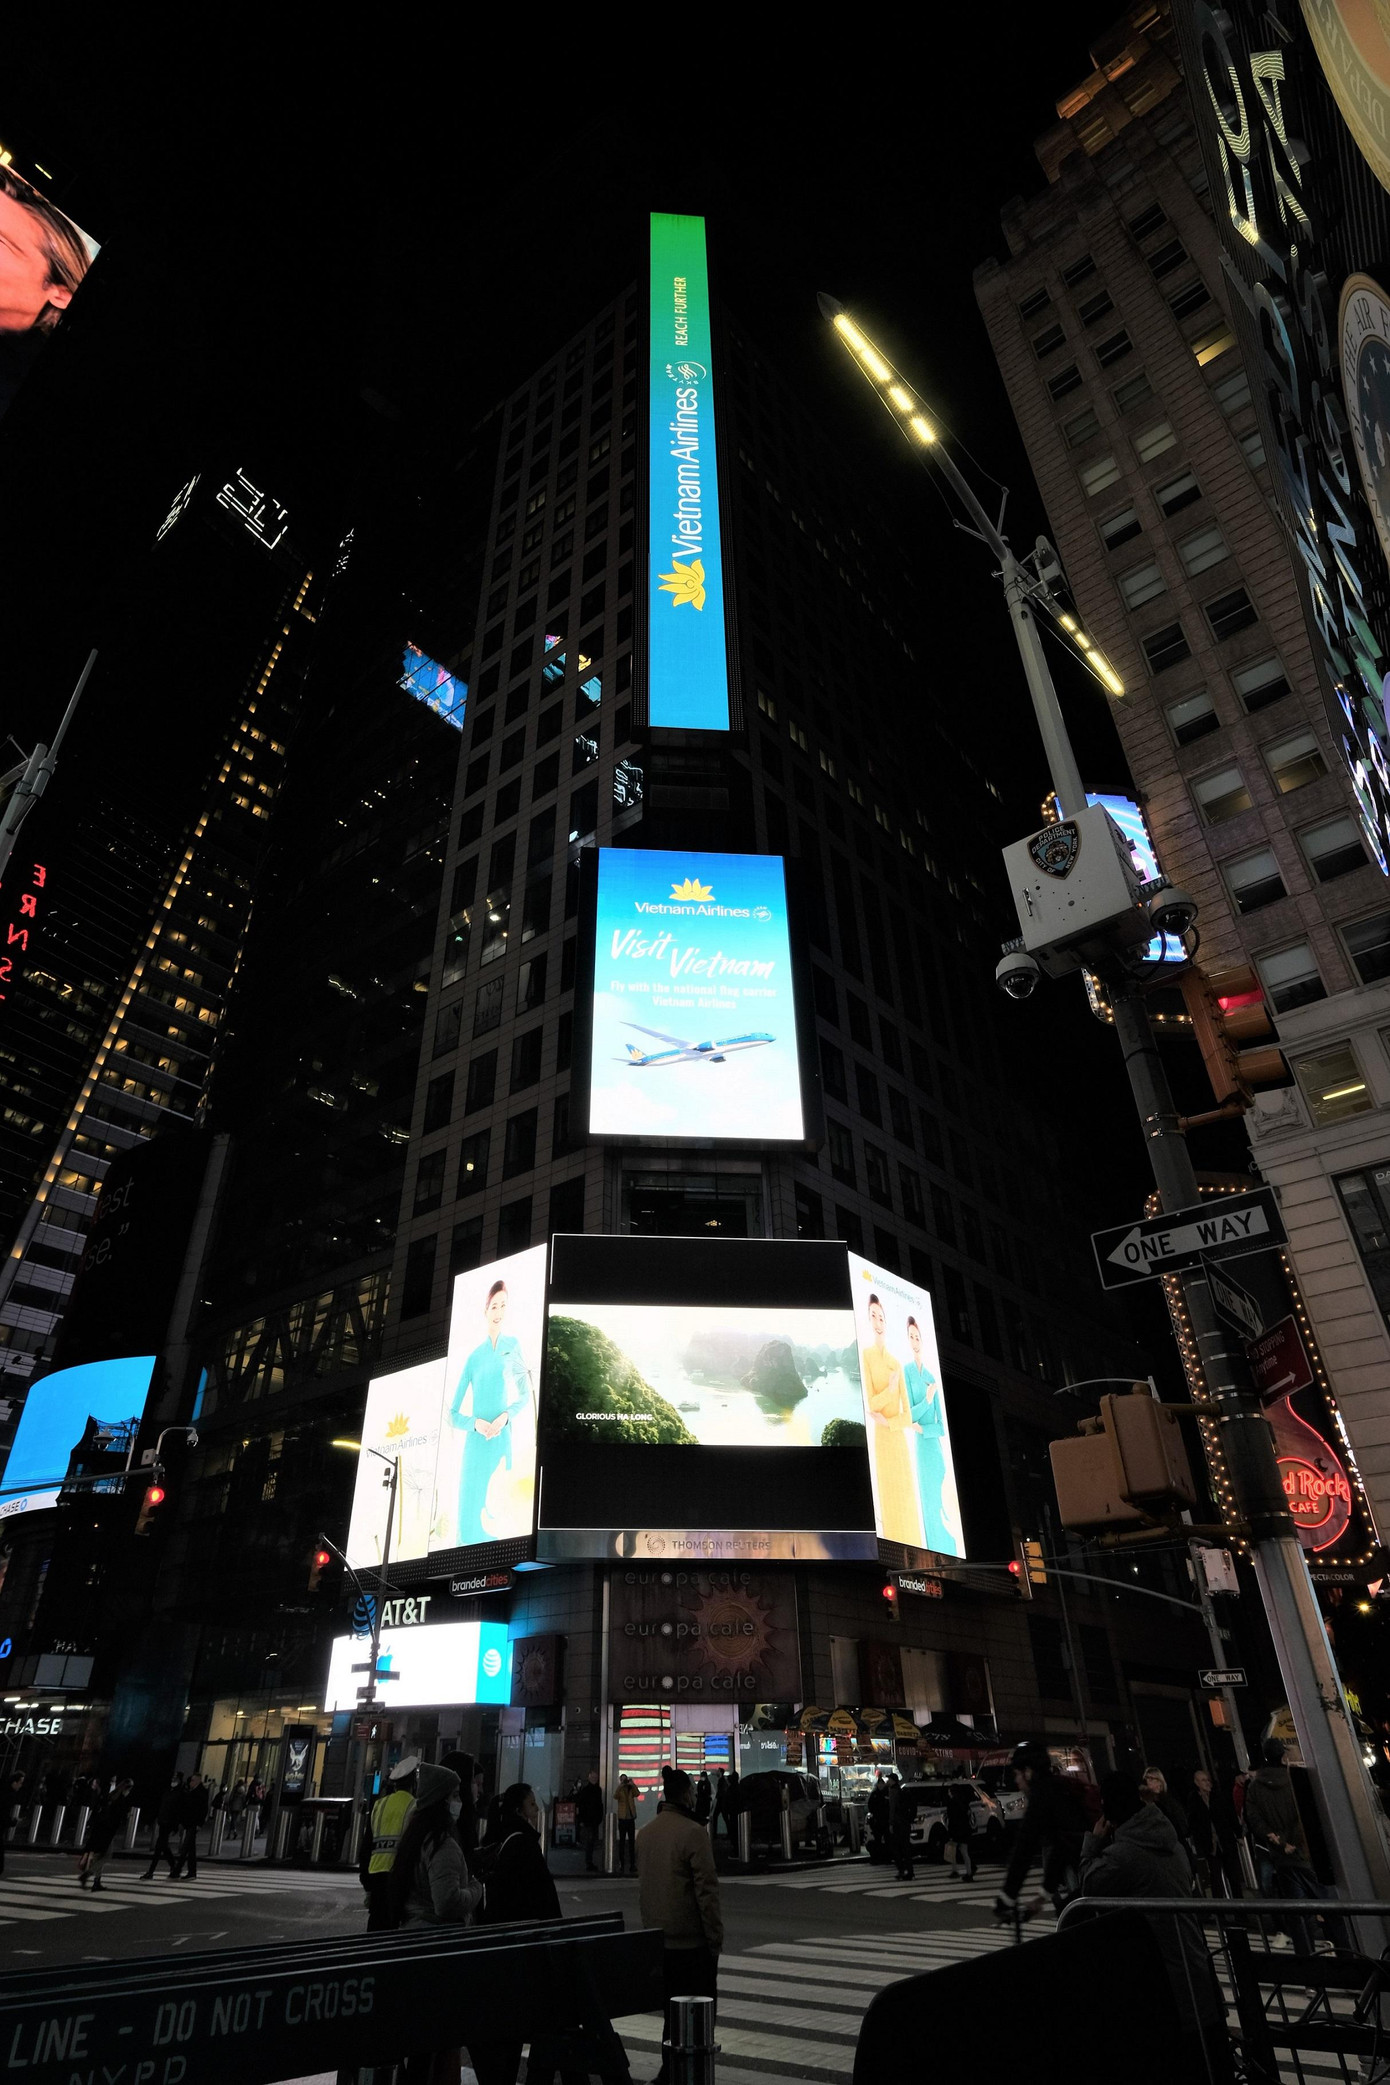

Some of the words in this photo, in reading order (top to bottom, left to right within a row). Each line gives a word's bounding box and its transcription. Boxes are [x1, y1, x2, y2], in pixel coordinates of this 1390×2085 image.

[673, 276, 687, 315] FURTHER
[1353, 297, 1376, 336] AIR
[1379, 305, 1390, 338] F
[674, 316, 688, 346] REACH
[1031, 828, 1076, 855] DEPARTMENT
[1038, 825, 1065, 842] POLICE
[1035, 857, 1047, 869] CITY
[1064, 854, 1075, 870] NEW
[610, 928, 678, 960] Visit
[669, 947, 776, 980] Vietnam
[610, 980, 626, 992] Fly
[628, 982, 650, 993] with
[652, 983, 670, 994] the
[673, 985, 717, 997] national
[652, 996, 695, 1008] Vietnam
[697, 999, 737, 1010] Airlines
[1124, 1233, 1175, 1264] ONE
[1196, 1211, 1253, 1245] WAY
[1259, 1329, 1286, 1357] STOPPING
[575, 1412, 616, 1421] GLORIOUS
[616, 1413, 629, 1421] HA
[630, 1413, 654, 1421] LONG
[1296, 1468, 1352, 1502] Rock
[1288, 1501, 1320, 1514] CAFE
[672, 1540, 723, 1550] THOMSON
[725, 1541, 771, 1550] REUTERS
[624, 1571, 700, 1588] europa
[380, 1596, 432, 1628] AT&T
[624, 1622, 701, 1639] europa
[623, 1675, 703, 1693] europa
[1206, 1675, 1220, 1683] ONE
[1225, 1674, 1240, 1682] WAY
[7, 2013, 96, 2069] LINE
[152, 1999, 197, 2046] DO
[209, 1990, 273, 2037] NOT
[284, 1976, 376, 2025] CROSS
